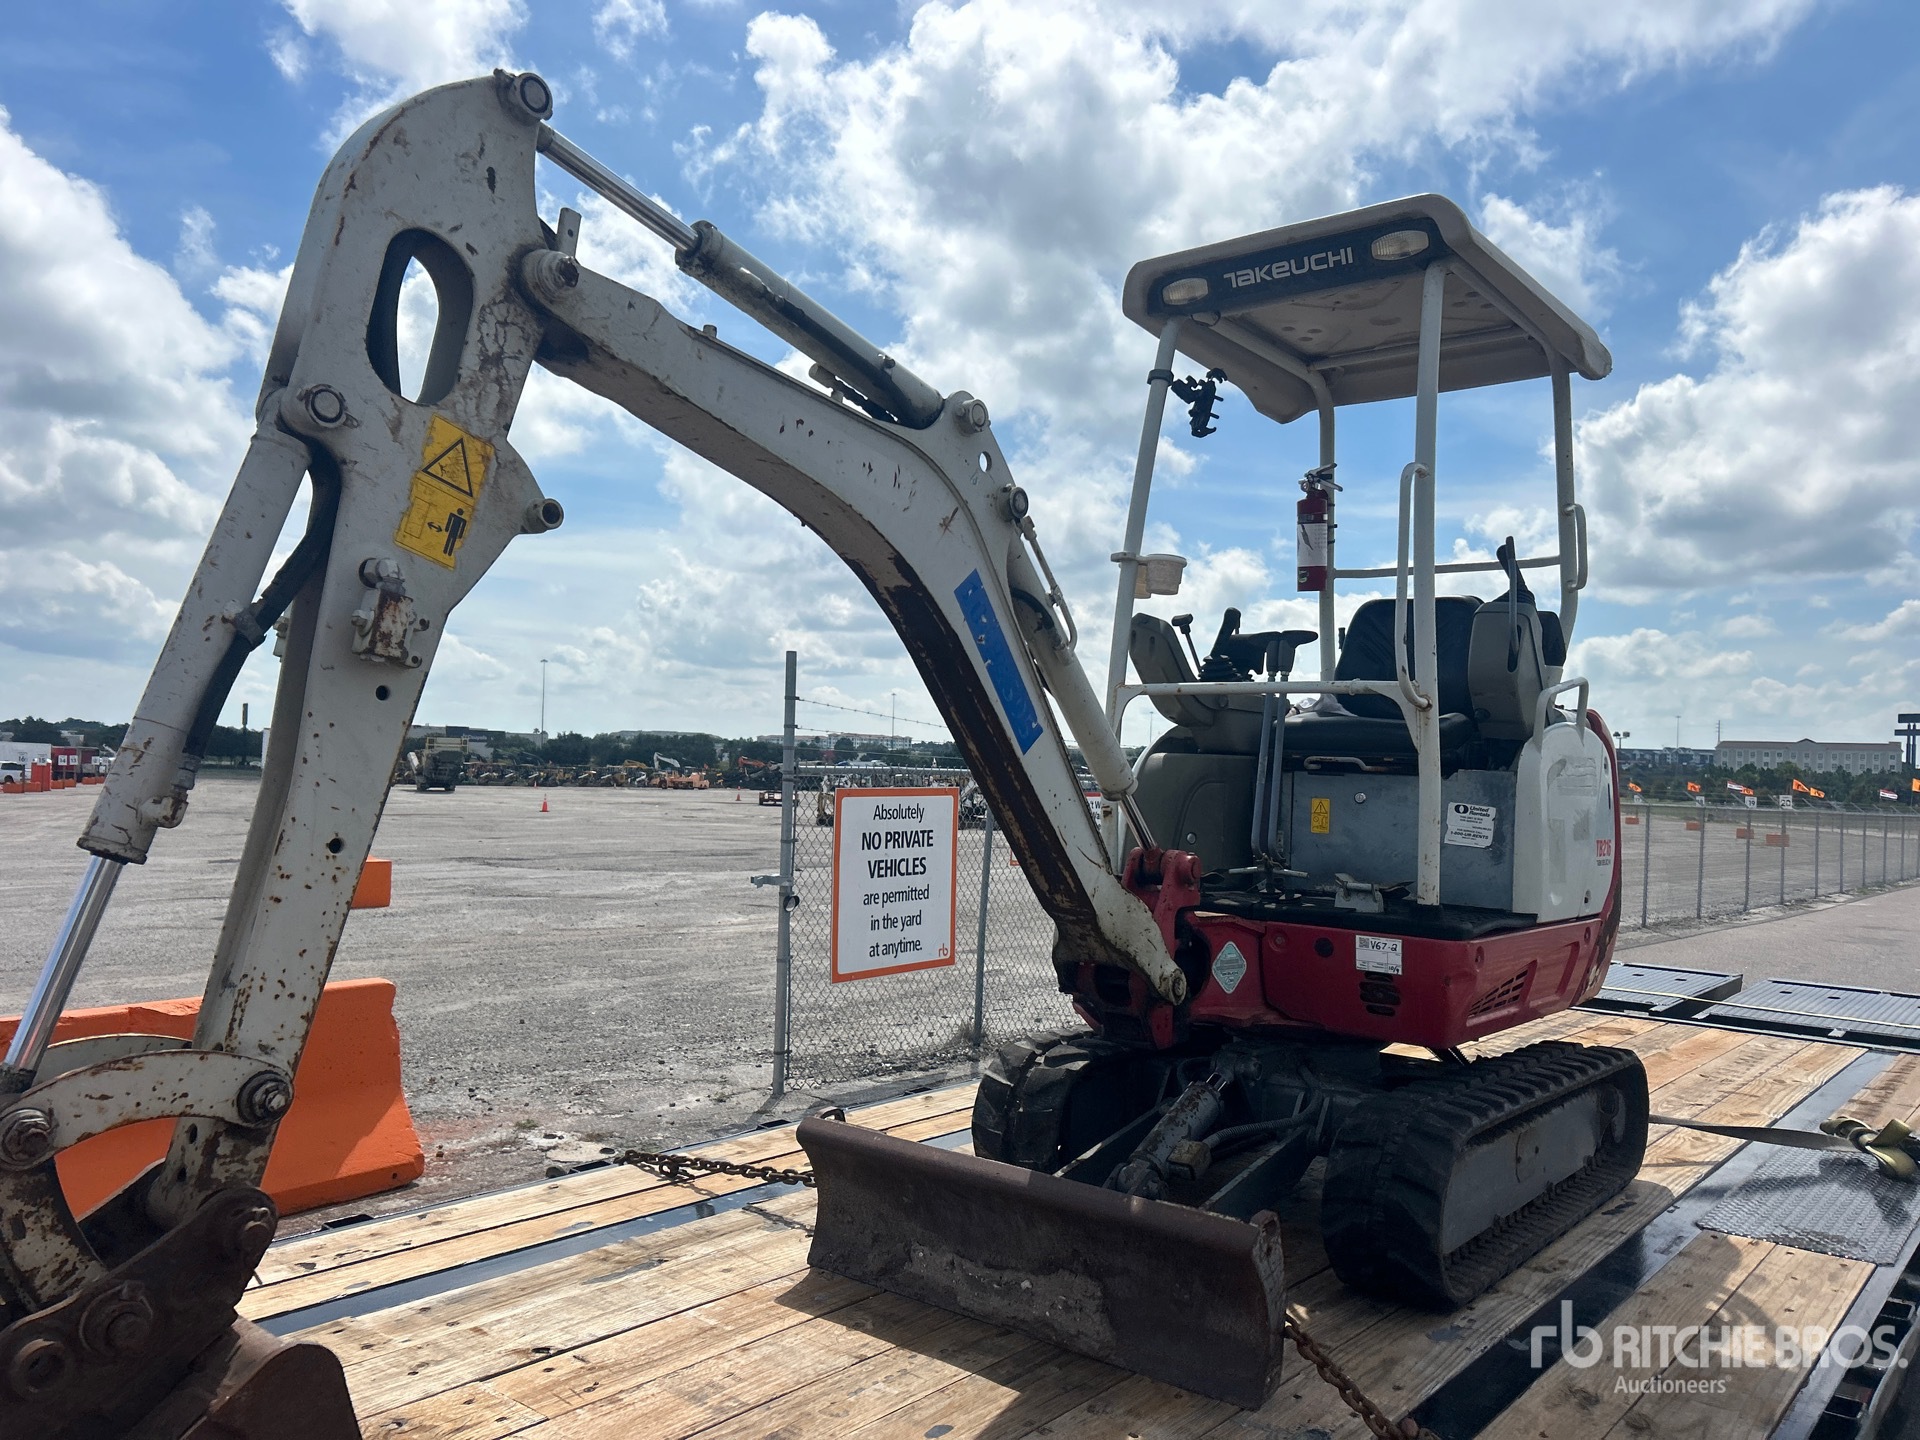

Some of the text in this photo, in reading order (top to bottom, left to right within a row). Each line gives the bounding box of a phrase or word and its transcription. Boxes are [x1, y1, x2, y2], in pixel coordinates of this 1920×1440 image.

[873, 803, 925, 823] Absolutely
[1780, 799, 1792, 807] 20
[861, 829, 934, 851] NO PRIVATE
[1596, 839, 1611, 857] TB216
[867, 856, 927, 879] VEHICLES
[863, 883, 930, 908] are permitted
[870, 909, 922, 932] in the yard
[869, 937, 923, 959] at anytime.
[938, 943, 949, 957] rb
